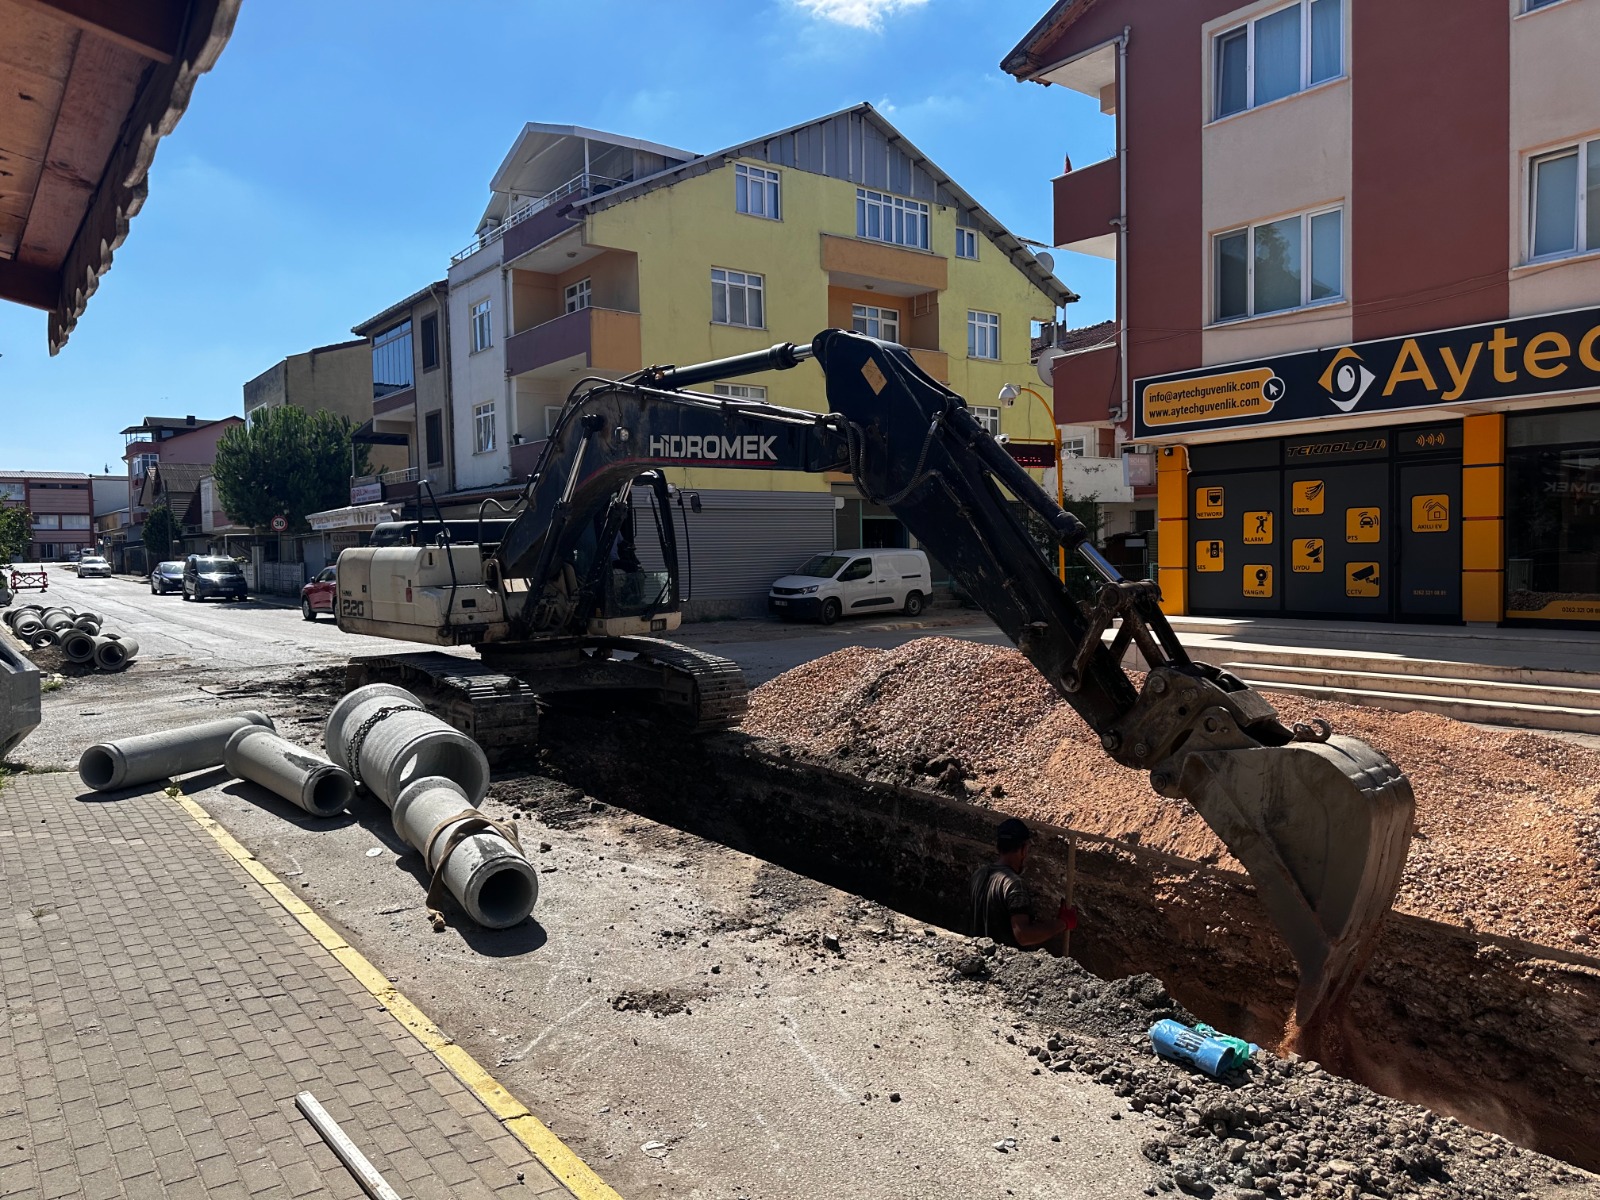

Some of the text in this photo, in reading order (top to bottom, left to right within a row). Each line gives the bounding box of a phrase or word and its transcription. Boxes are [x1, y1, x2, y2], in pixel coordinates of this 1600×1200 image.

[1149, 380, 1260, 403] info@aytechguvenlik.com
[1149, 397, 1260, 418] www.aytechguvenlik.com
[343, 600, 364, 616] 220
